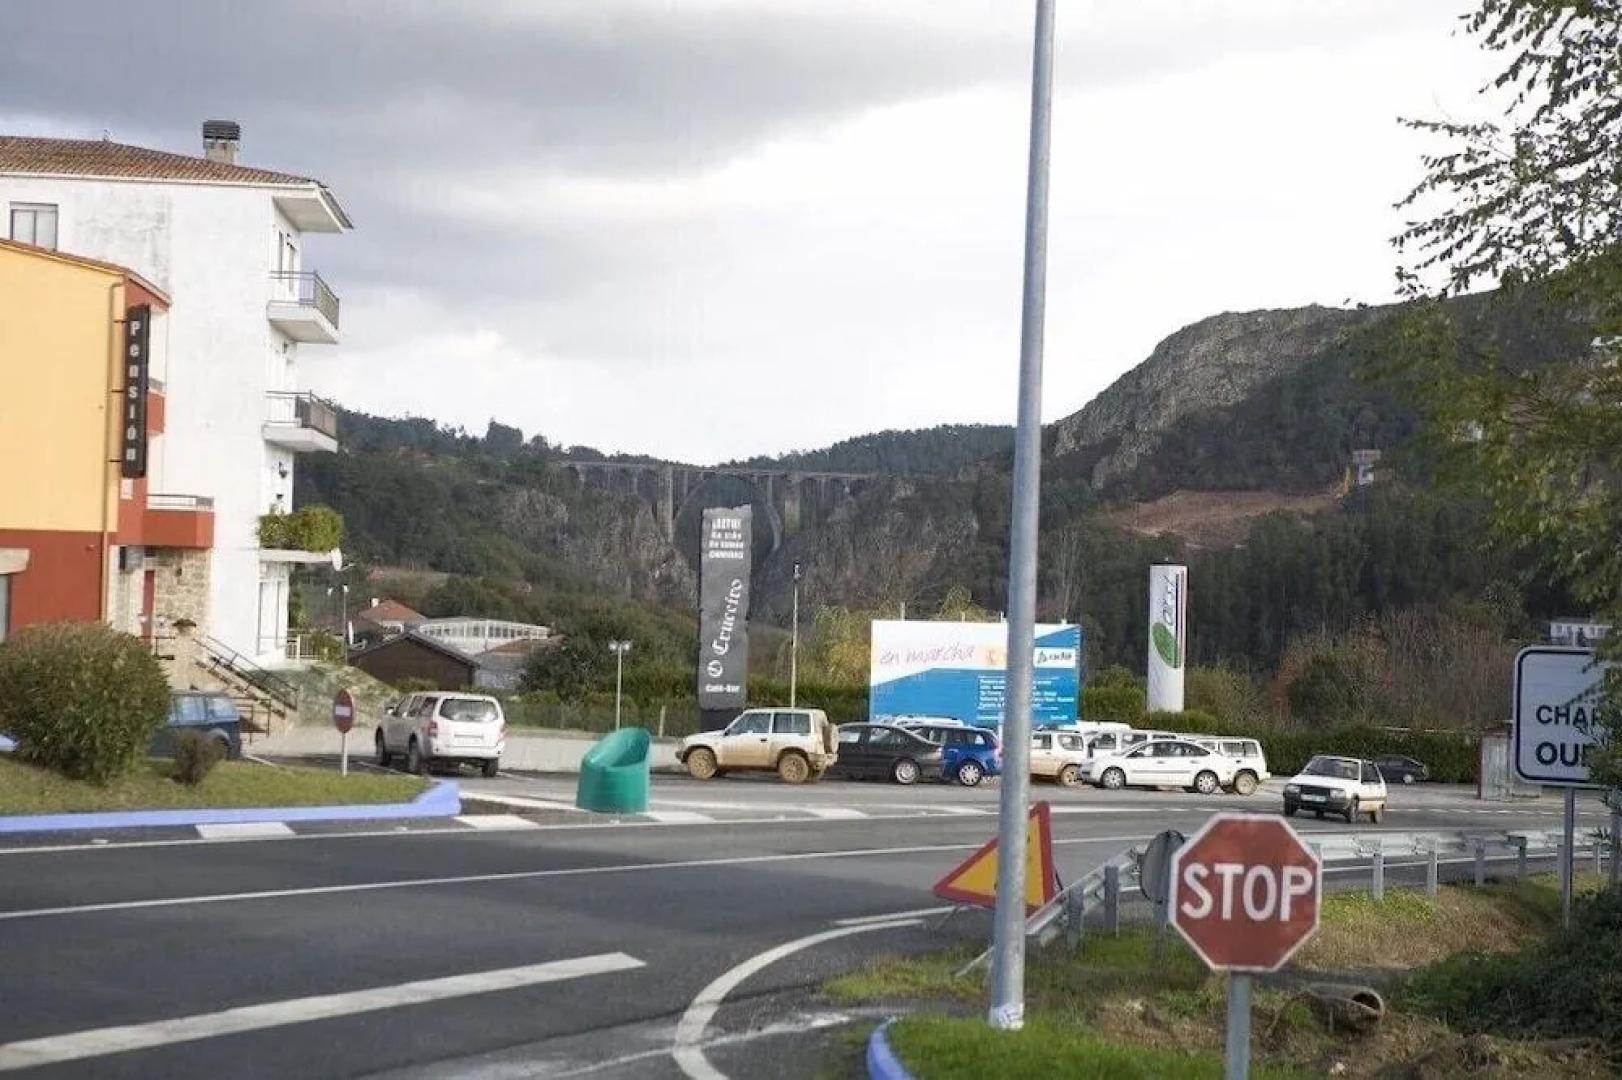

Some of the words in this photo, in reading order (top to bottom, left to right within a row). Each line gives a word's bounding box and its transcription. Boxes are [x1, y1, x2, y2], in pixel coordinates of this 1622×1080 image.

[126, 320, 141, 461] Pensión
[906, 642, 976, 664] marcha
[1181, 863, 1313, 921] STOP
